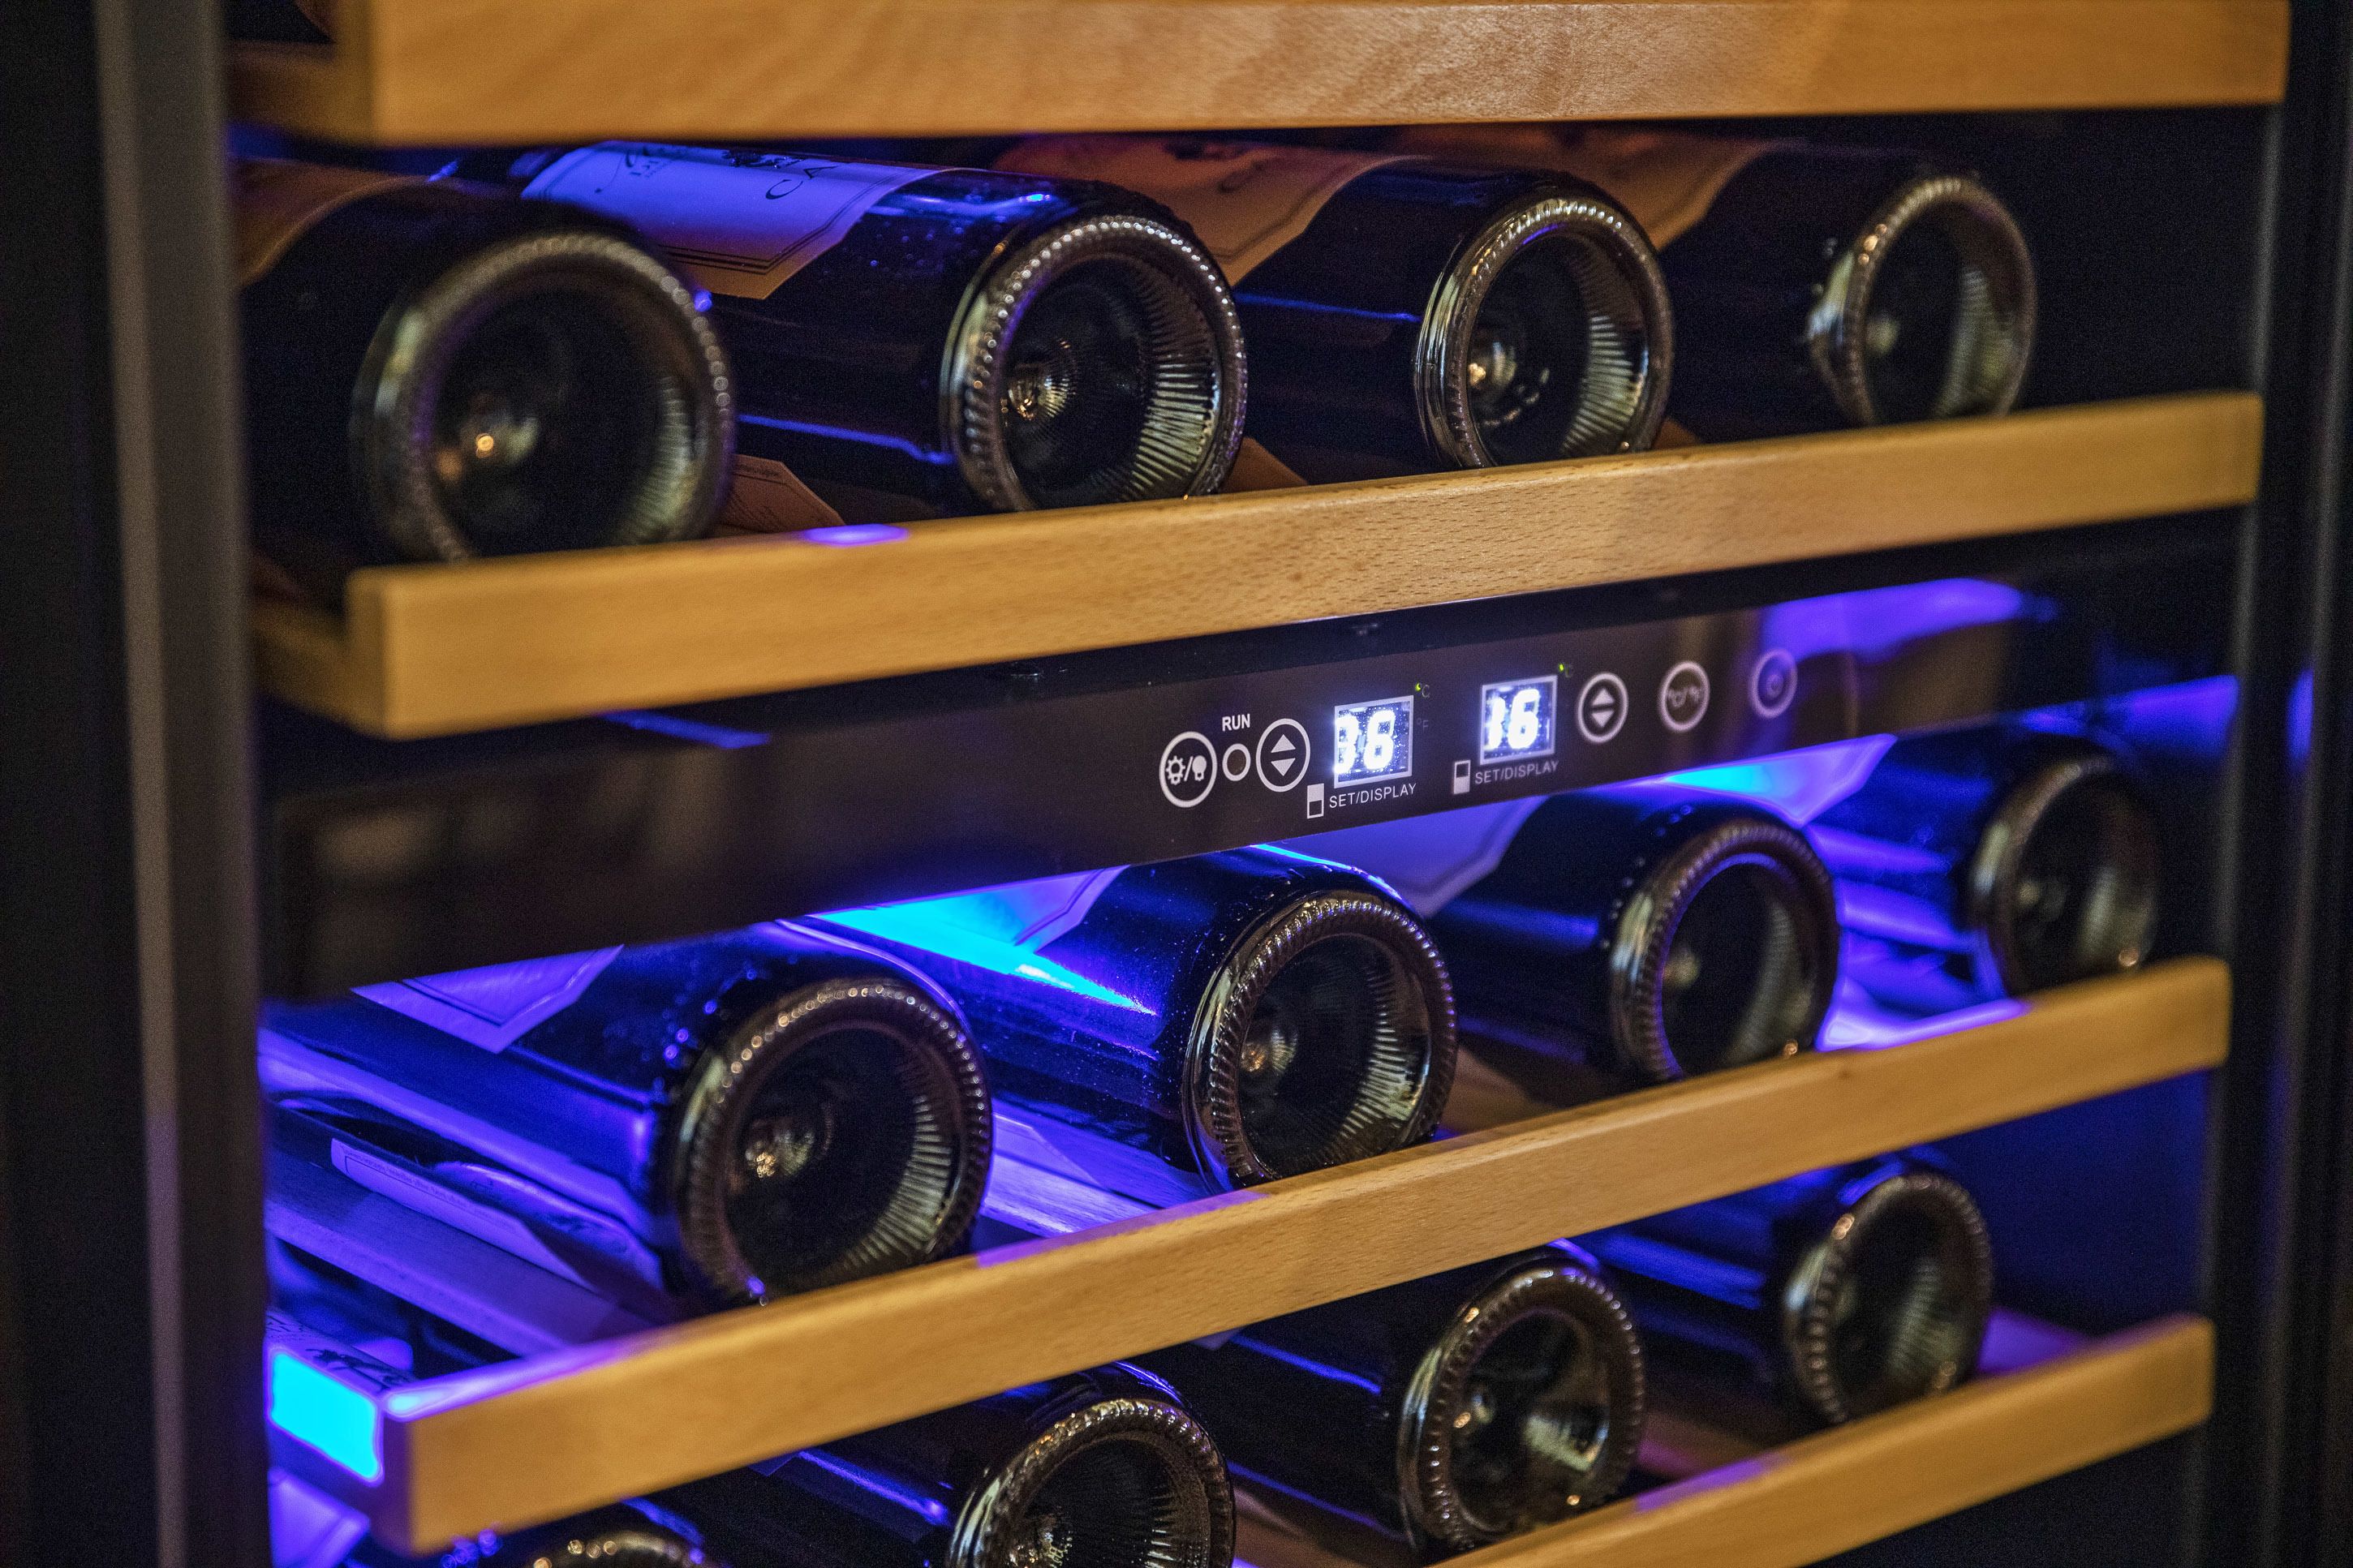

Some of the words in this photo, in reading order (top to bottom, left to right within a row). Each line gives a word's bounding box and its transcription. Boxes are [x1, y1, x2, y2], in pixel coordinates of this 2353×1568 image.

[1222, 714, 1250, 732] RUN
[1474, 760, 1559, 784] SET/DISPLAY
[1329, 783, 1417, 809] SET/DISPLAY
